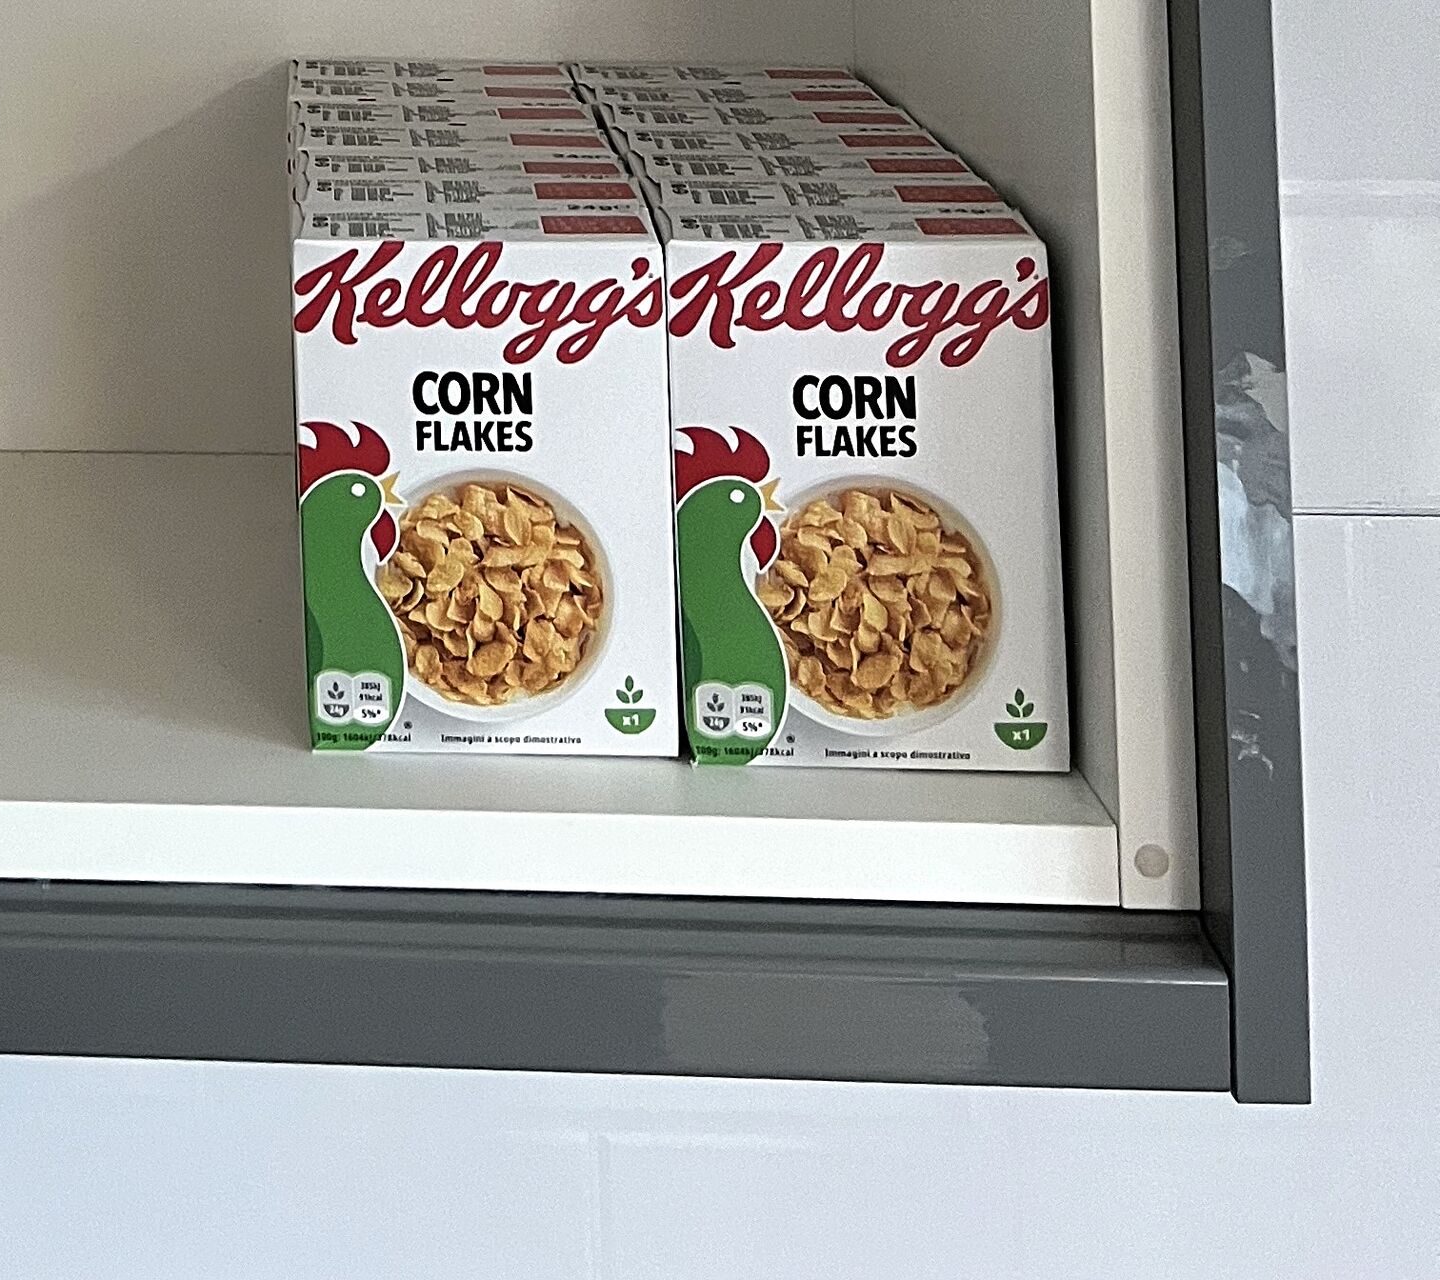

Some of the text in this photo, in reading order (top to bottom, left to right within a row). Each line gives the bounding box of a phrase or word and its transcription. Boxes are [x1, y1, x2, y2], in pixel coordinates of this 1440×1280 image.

[294, 241, 662, 364] Kellogg's
[669, 242, 1049, 368] Kellogg's
[412, 371, 532, 414] CORN
[792, 374, 917, 420] CORN
[416, 420, 533, 452] FLAKES
[796, 425, 917, 457] FLAKES
[622, 714, 640, 726] x1
[1011, 729, 1030, 741] x1
